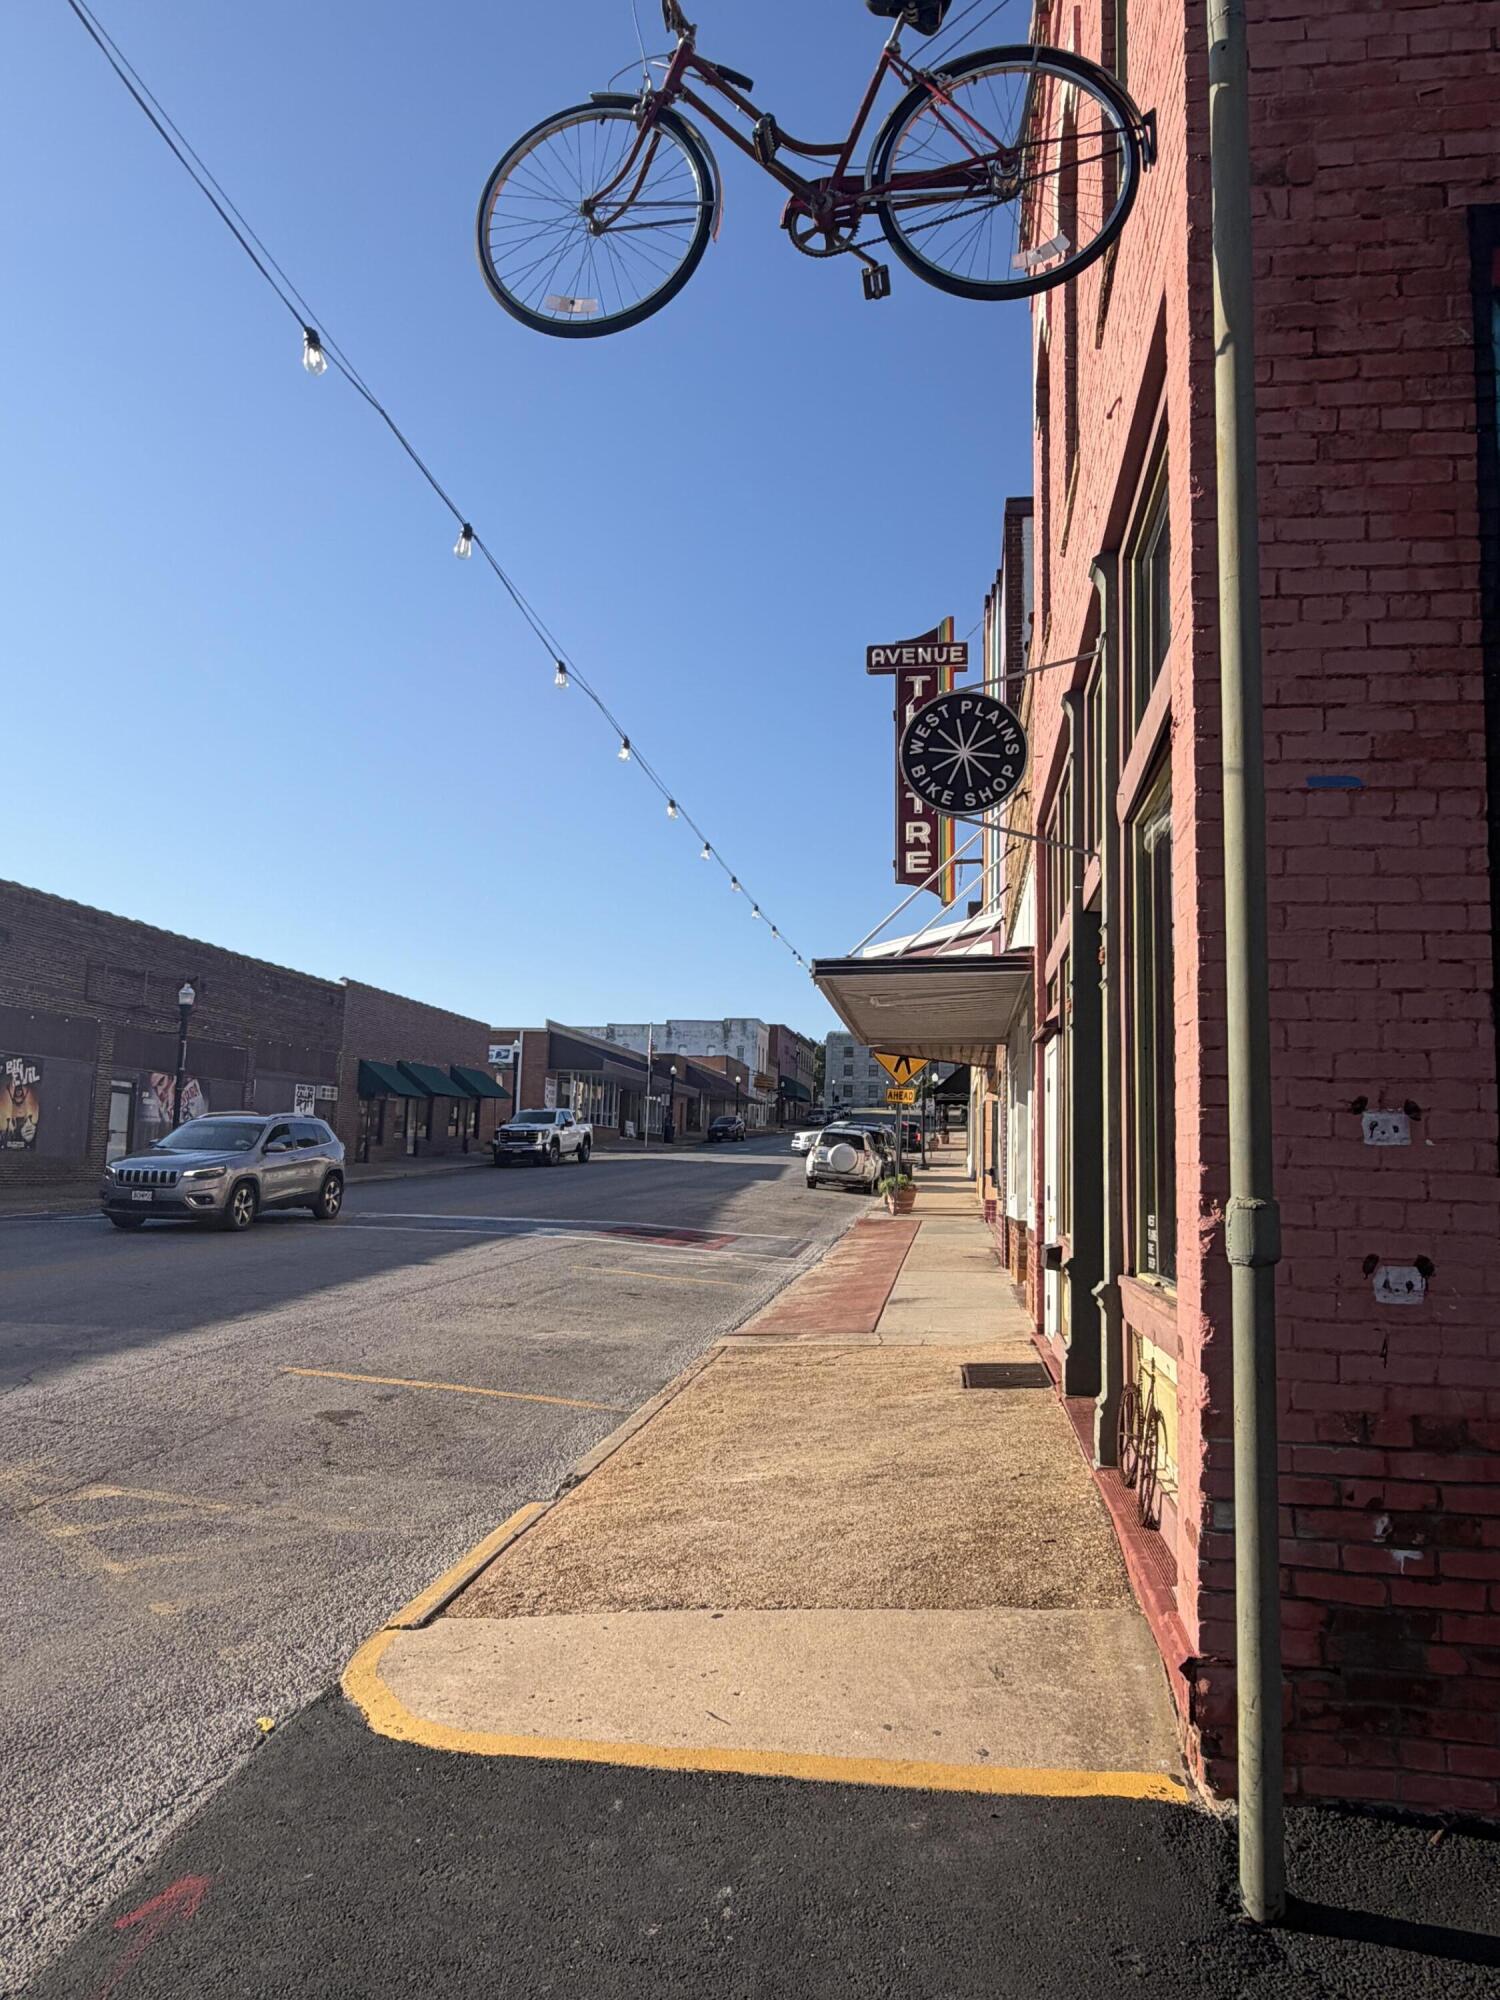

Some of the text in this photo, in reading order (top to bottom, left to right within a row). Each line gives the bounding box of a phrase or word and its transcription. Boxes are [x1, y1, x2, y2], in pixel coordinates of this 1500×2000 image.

[871, 646, 965, 666] AVENUE
[909, 700, 1020, 755] WEST PLAINS
[911, 764, 1015, 807] BIKE SHOP
[887, 1090, 914, 1101] AHEAD
